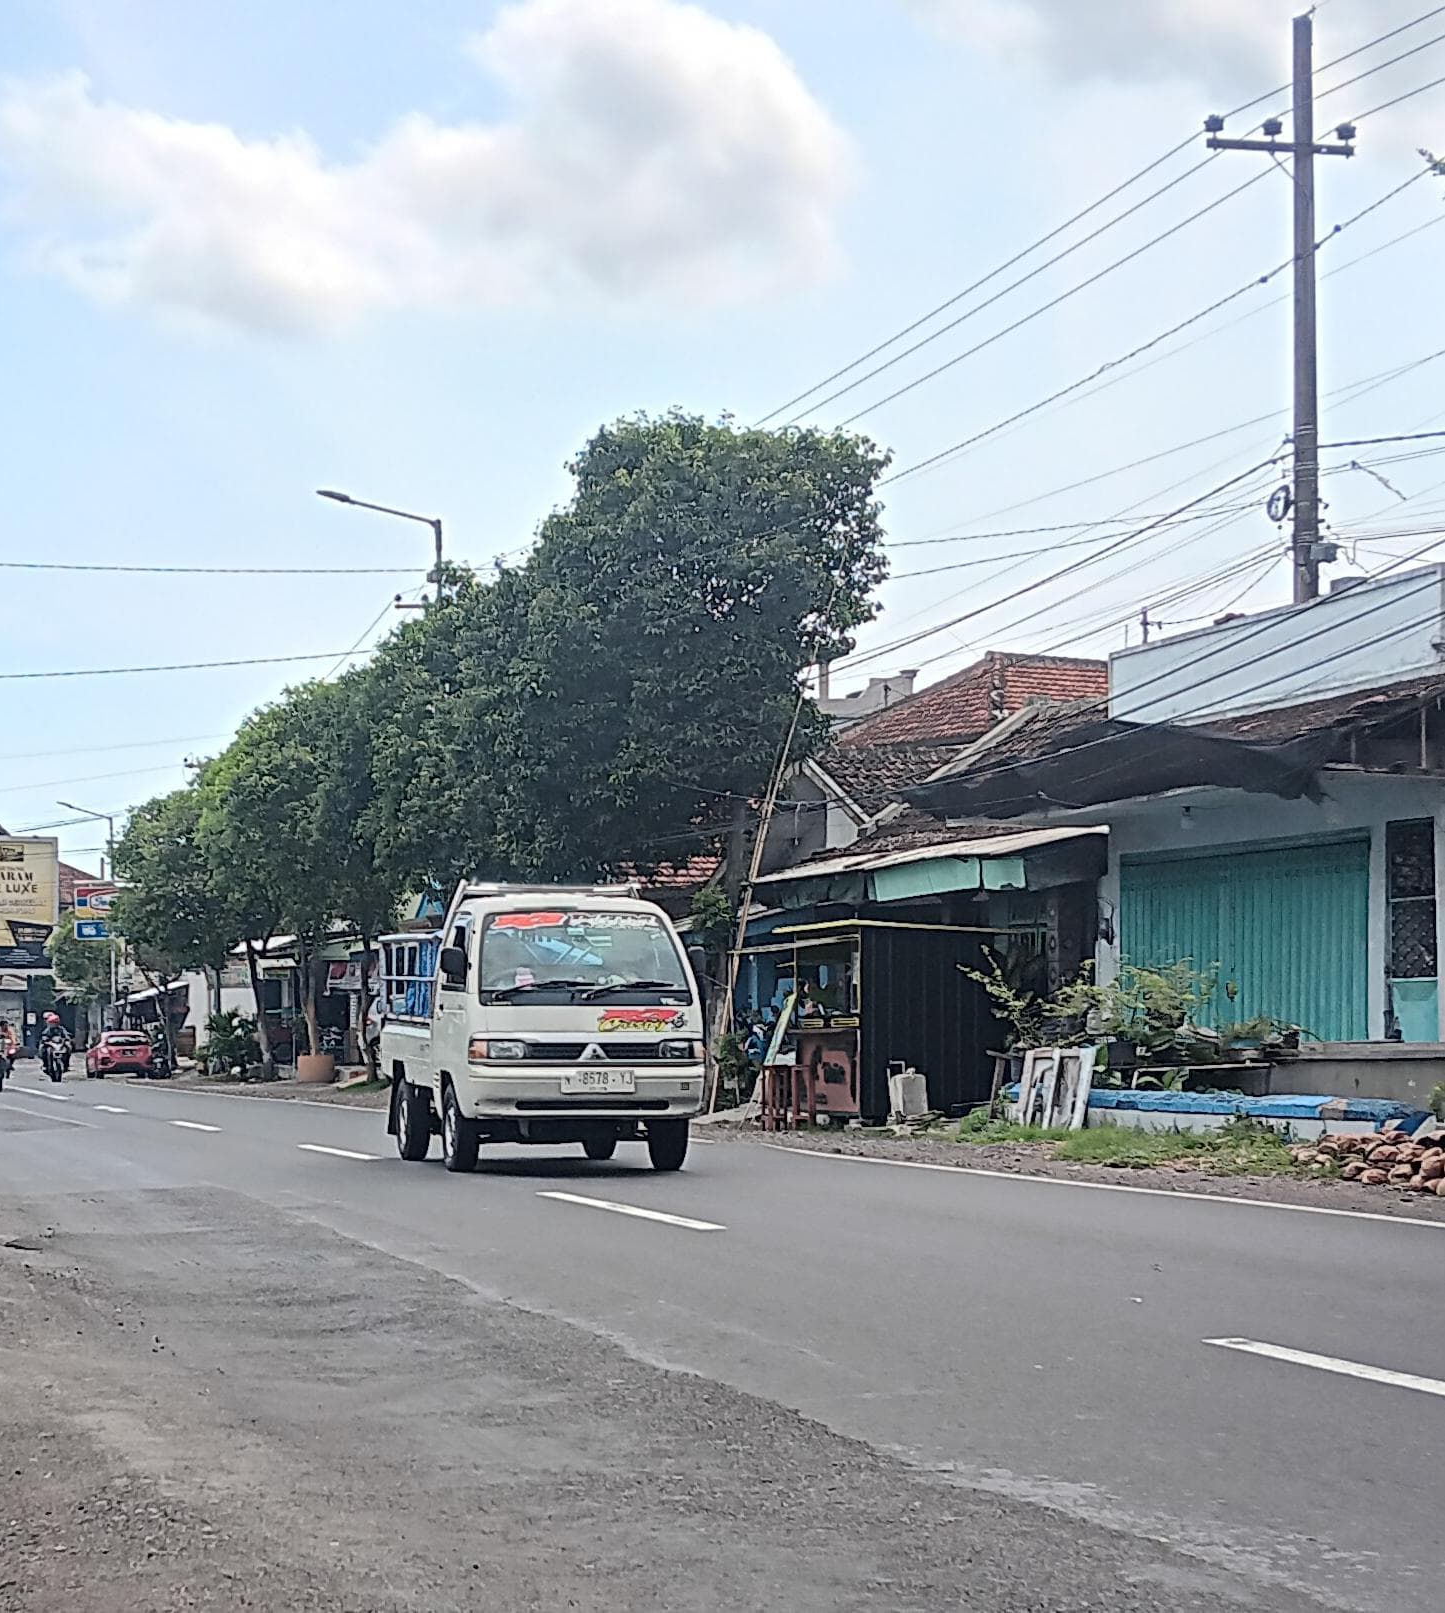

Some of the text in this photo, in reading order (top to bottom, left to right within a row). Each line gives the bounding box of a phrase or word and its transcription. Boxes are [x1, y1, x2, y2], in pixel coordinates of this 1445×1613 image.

[5, 882, 38, 895] LUXE
[582, 1071, 609, 1085] 8578
[620, 1071, 634, 1084] YJ
